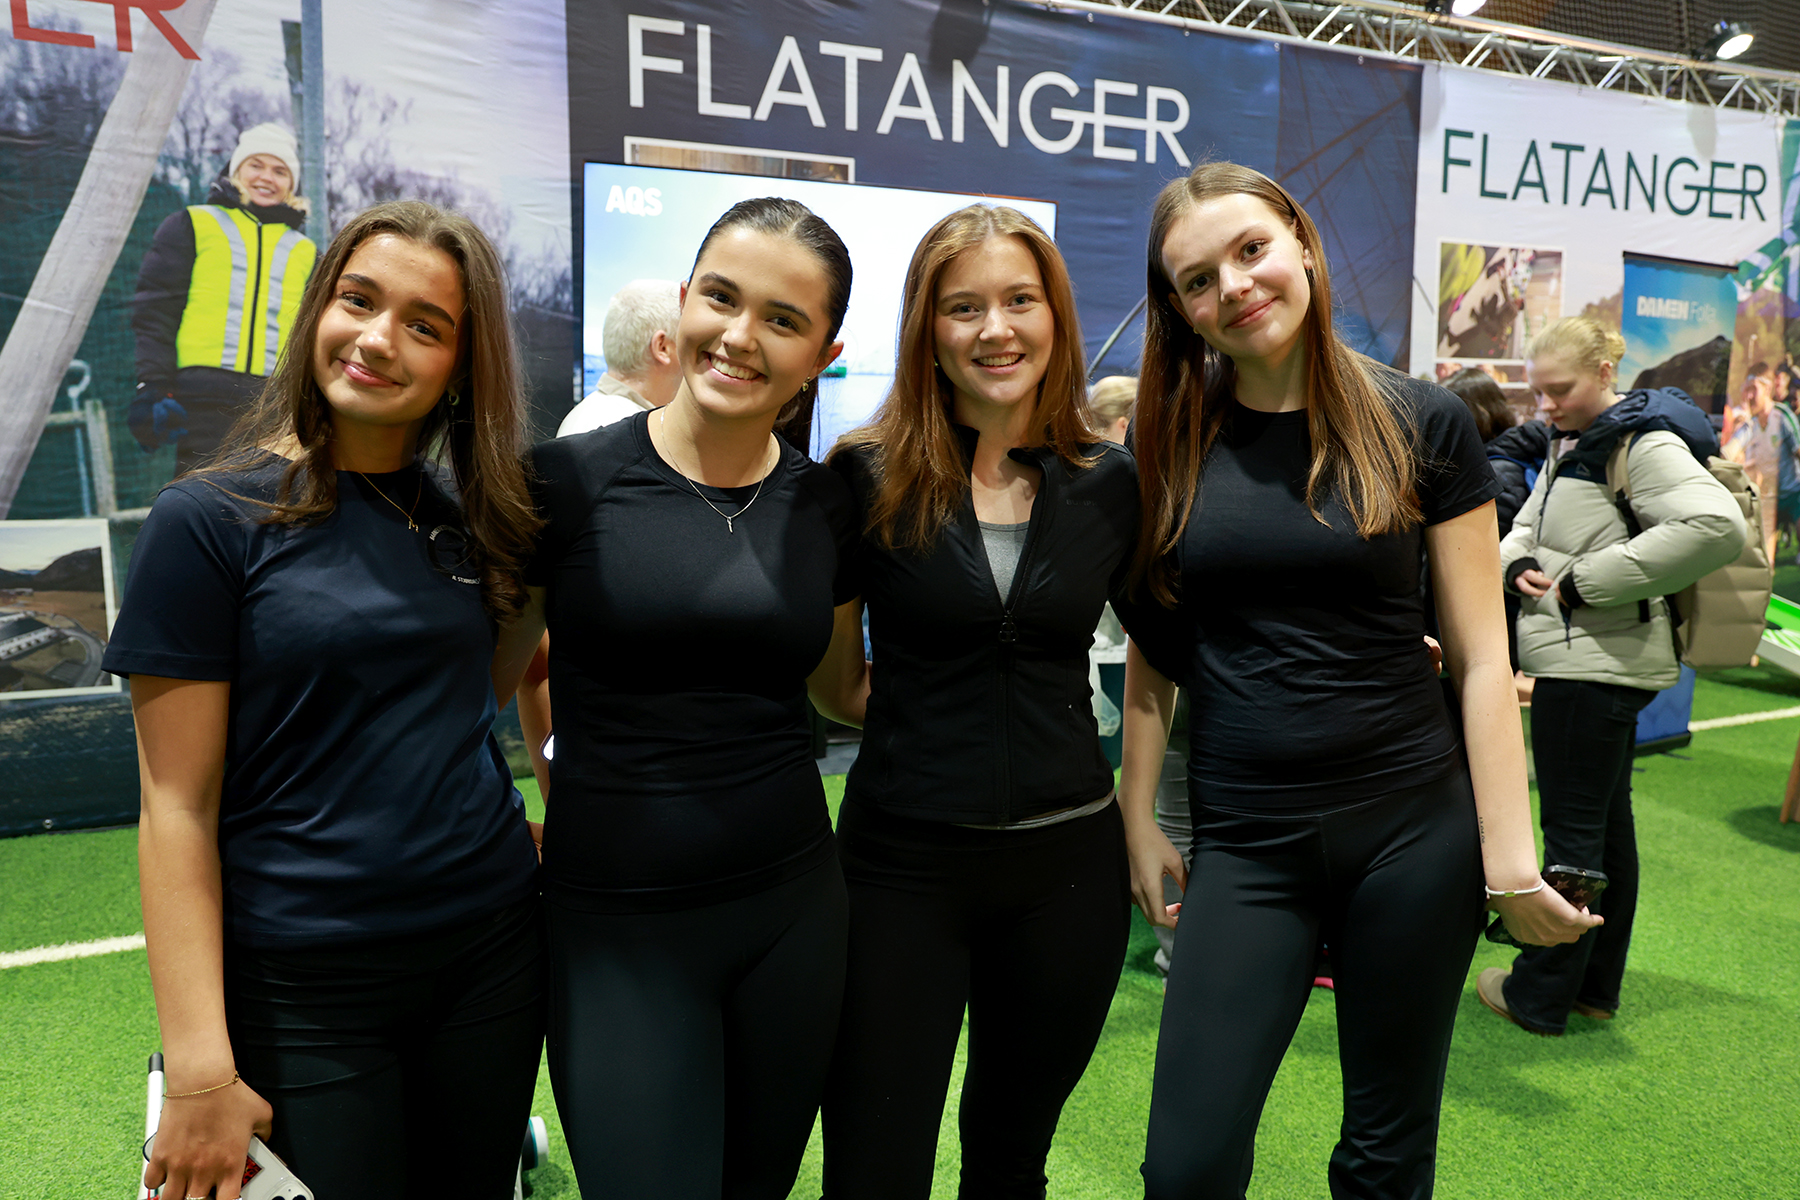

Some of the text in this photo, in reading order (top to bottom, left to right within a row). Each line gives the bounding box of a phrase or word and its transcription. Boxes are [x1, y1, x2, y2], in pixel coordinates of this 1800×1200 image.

[627, 14, 1191, 167] FLATANGER
[605, 184, 663, 218] AQS
[1442, 128, 1766, 221] FLATANGER
[1636, 295, 1690, 321] DAMEN
